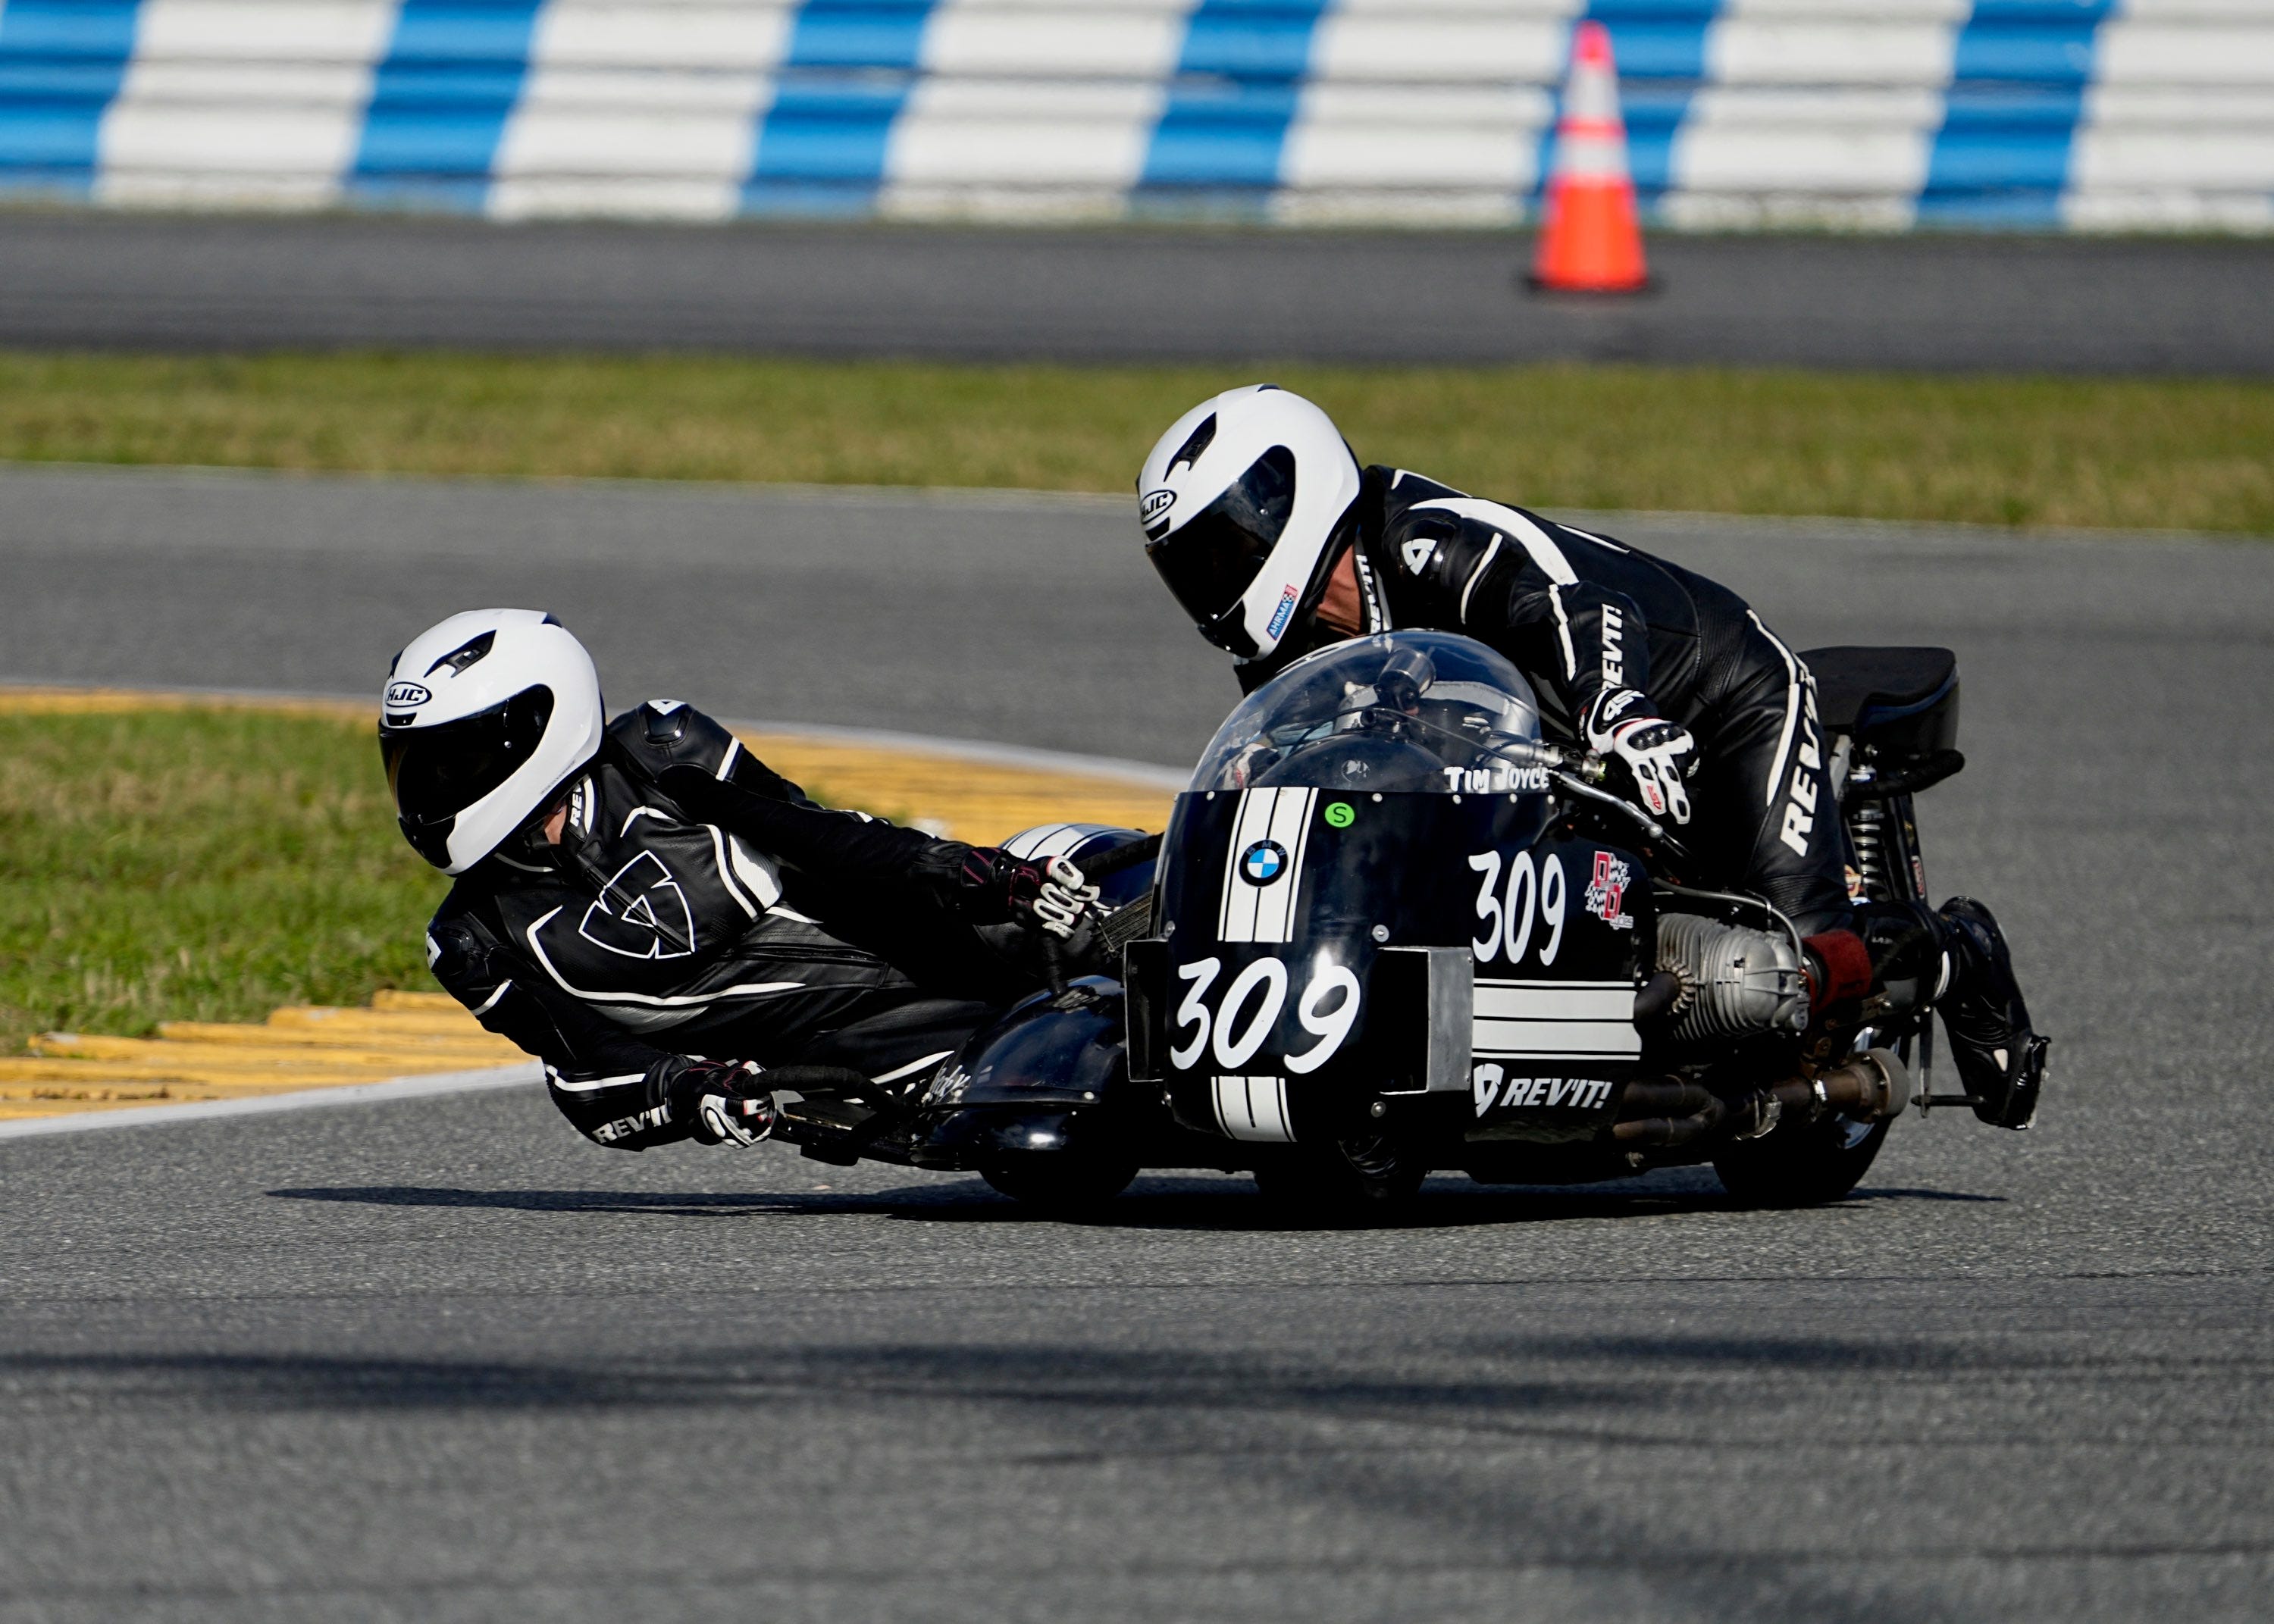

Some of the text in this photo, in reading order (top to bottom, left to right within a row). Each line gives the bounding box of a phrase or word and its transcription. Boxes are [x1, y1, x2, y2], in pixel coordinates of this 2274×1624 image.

[1269, 602, 1292, 636] AHRMA
[387, 688, 424, 702] HJC
[1444, 766, 1550, 794] TIM JOYCE
[1333, 806, 1347, 824] S
[1245, 840, 1287, 857] BMW
[1468, 850, 1567, 966] 309
[1170, 956, 1361, 1075] 309
[1499, 1078, 1613, 1109] REV'IT!
